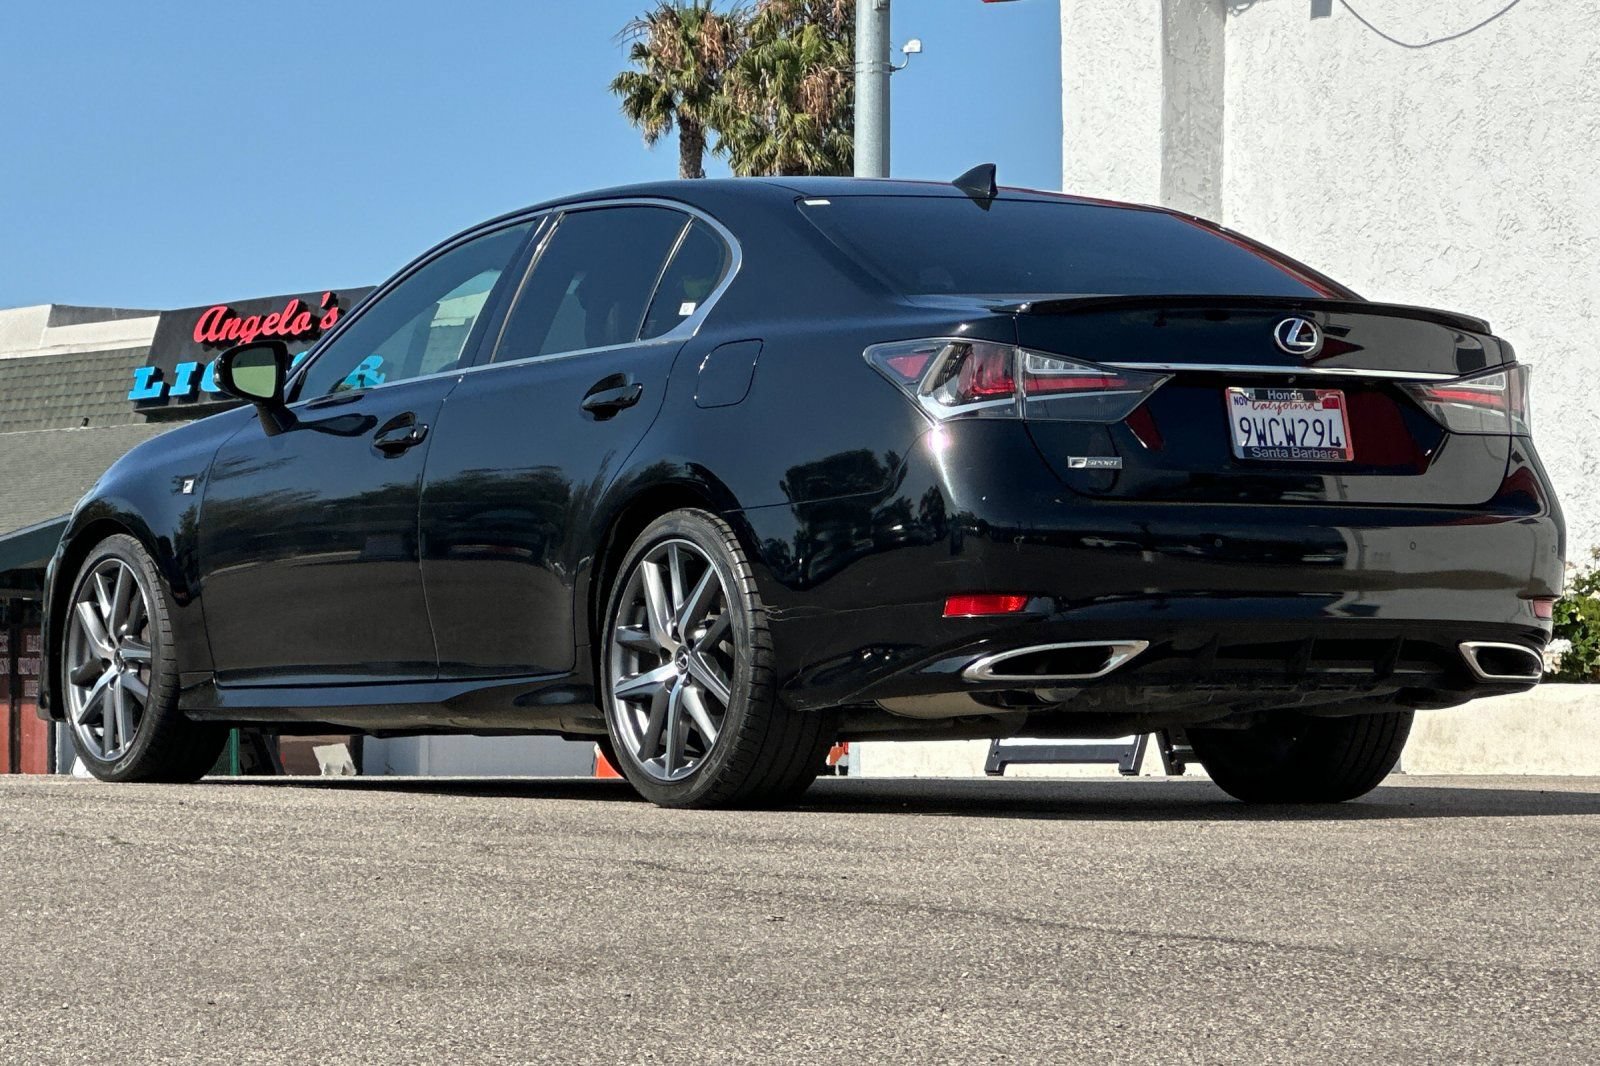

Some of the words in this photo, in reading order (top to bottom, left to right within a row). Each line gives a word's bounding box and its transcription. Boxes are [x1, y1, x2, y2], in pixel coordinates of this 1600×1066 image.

[193, 291, 339, 345] Angelo's
[1267, 390, 1304, 400] Honda
[1240, 417, 1342, 447] 9WCW294
[1251, 447, 1289, 458] Santa
[1291, 448, 1340, 460] Barbara
